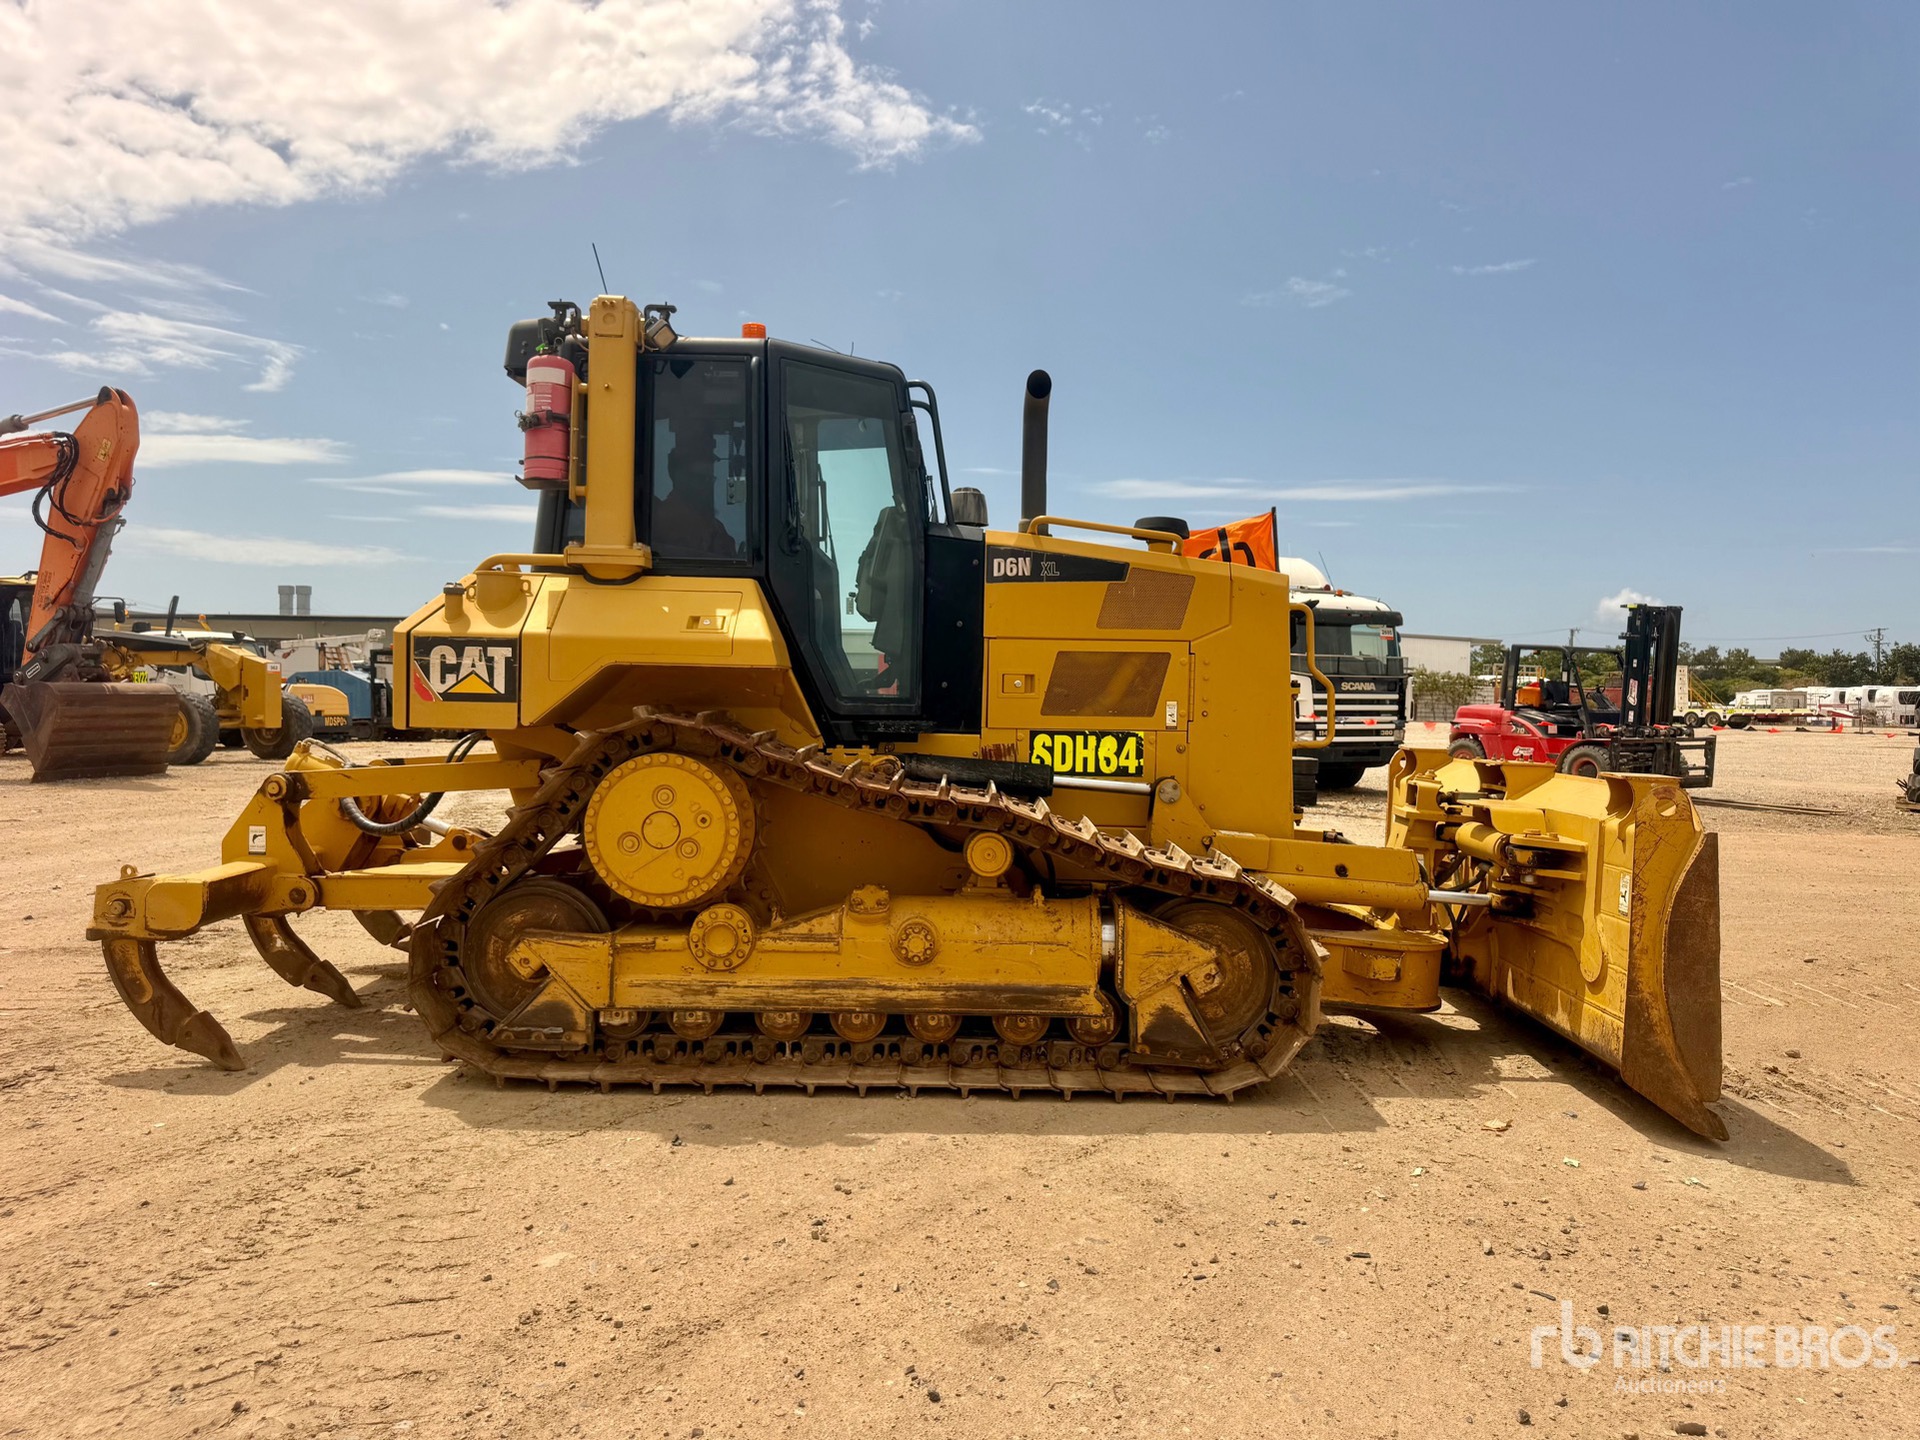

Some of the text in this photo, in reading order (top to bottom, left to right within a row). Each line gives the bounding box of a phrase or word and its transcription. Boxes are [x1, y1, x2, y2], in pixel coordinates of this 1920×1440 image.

[993, 557, 1060, 577] D6N XL
[429, 645, 513, 695] CAT
[1341, 682, 1376, 691] SCANIA
